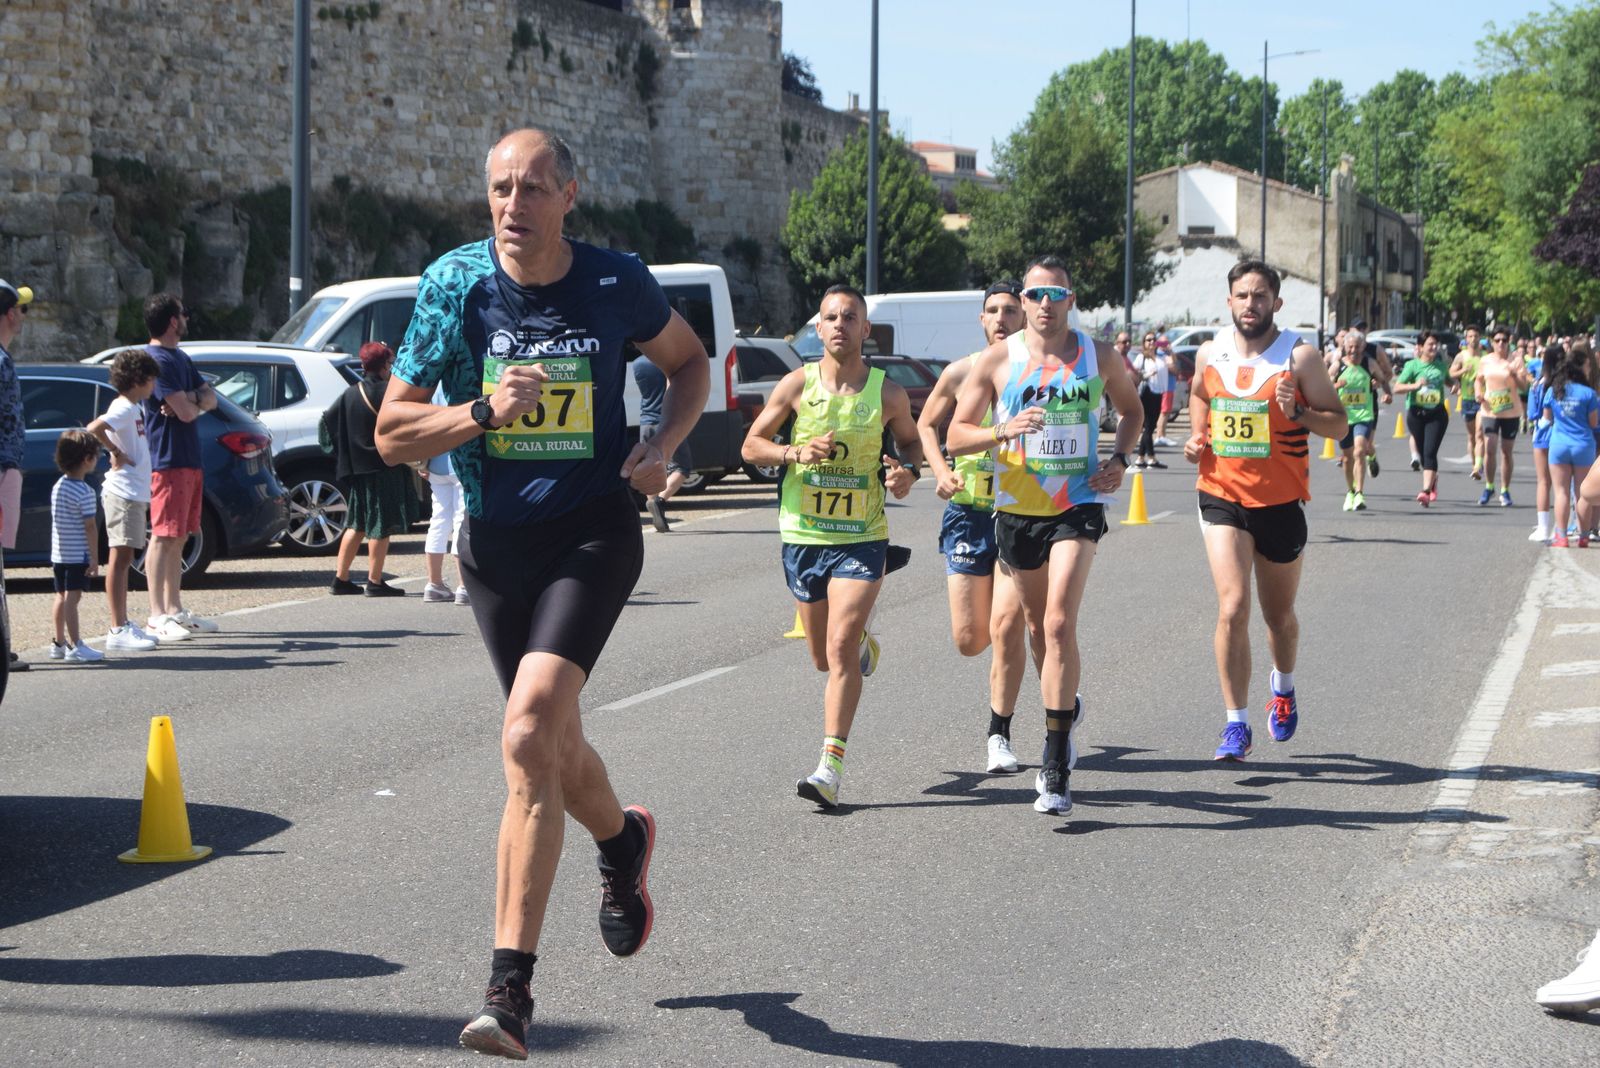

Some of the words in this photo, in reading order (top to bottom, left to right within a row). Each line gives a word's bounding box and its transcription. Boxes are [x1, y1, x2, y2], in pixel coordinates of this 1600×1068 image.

[545, 363, 577, 372] ACION
[1223, 415, 1254, 439] 35
[514, 441, 544, 452] CAJA
[546, 440, 587, 451] RURAL
[1039, 439, 1065, 455] ALEX
[1070, 438, 1077, 455] D
[1064, 462, 1086, 470] RURAL
[812, 491, 853, 516] 171
[836, 524, 862, 532] RURAL
